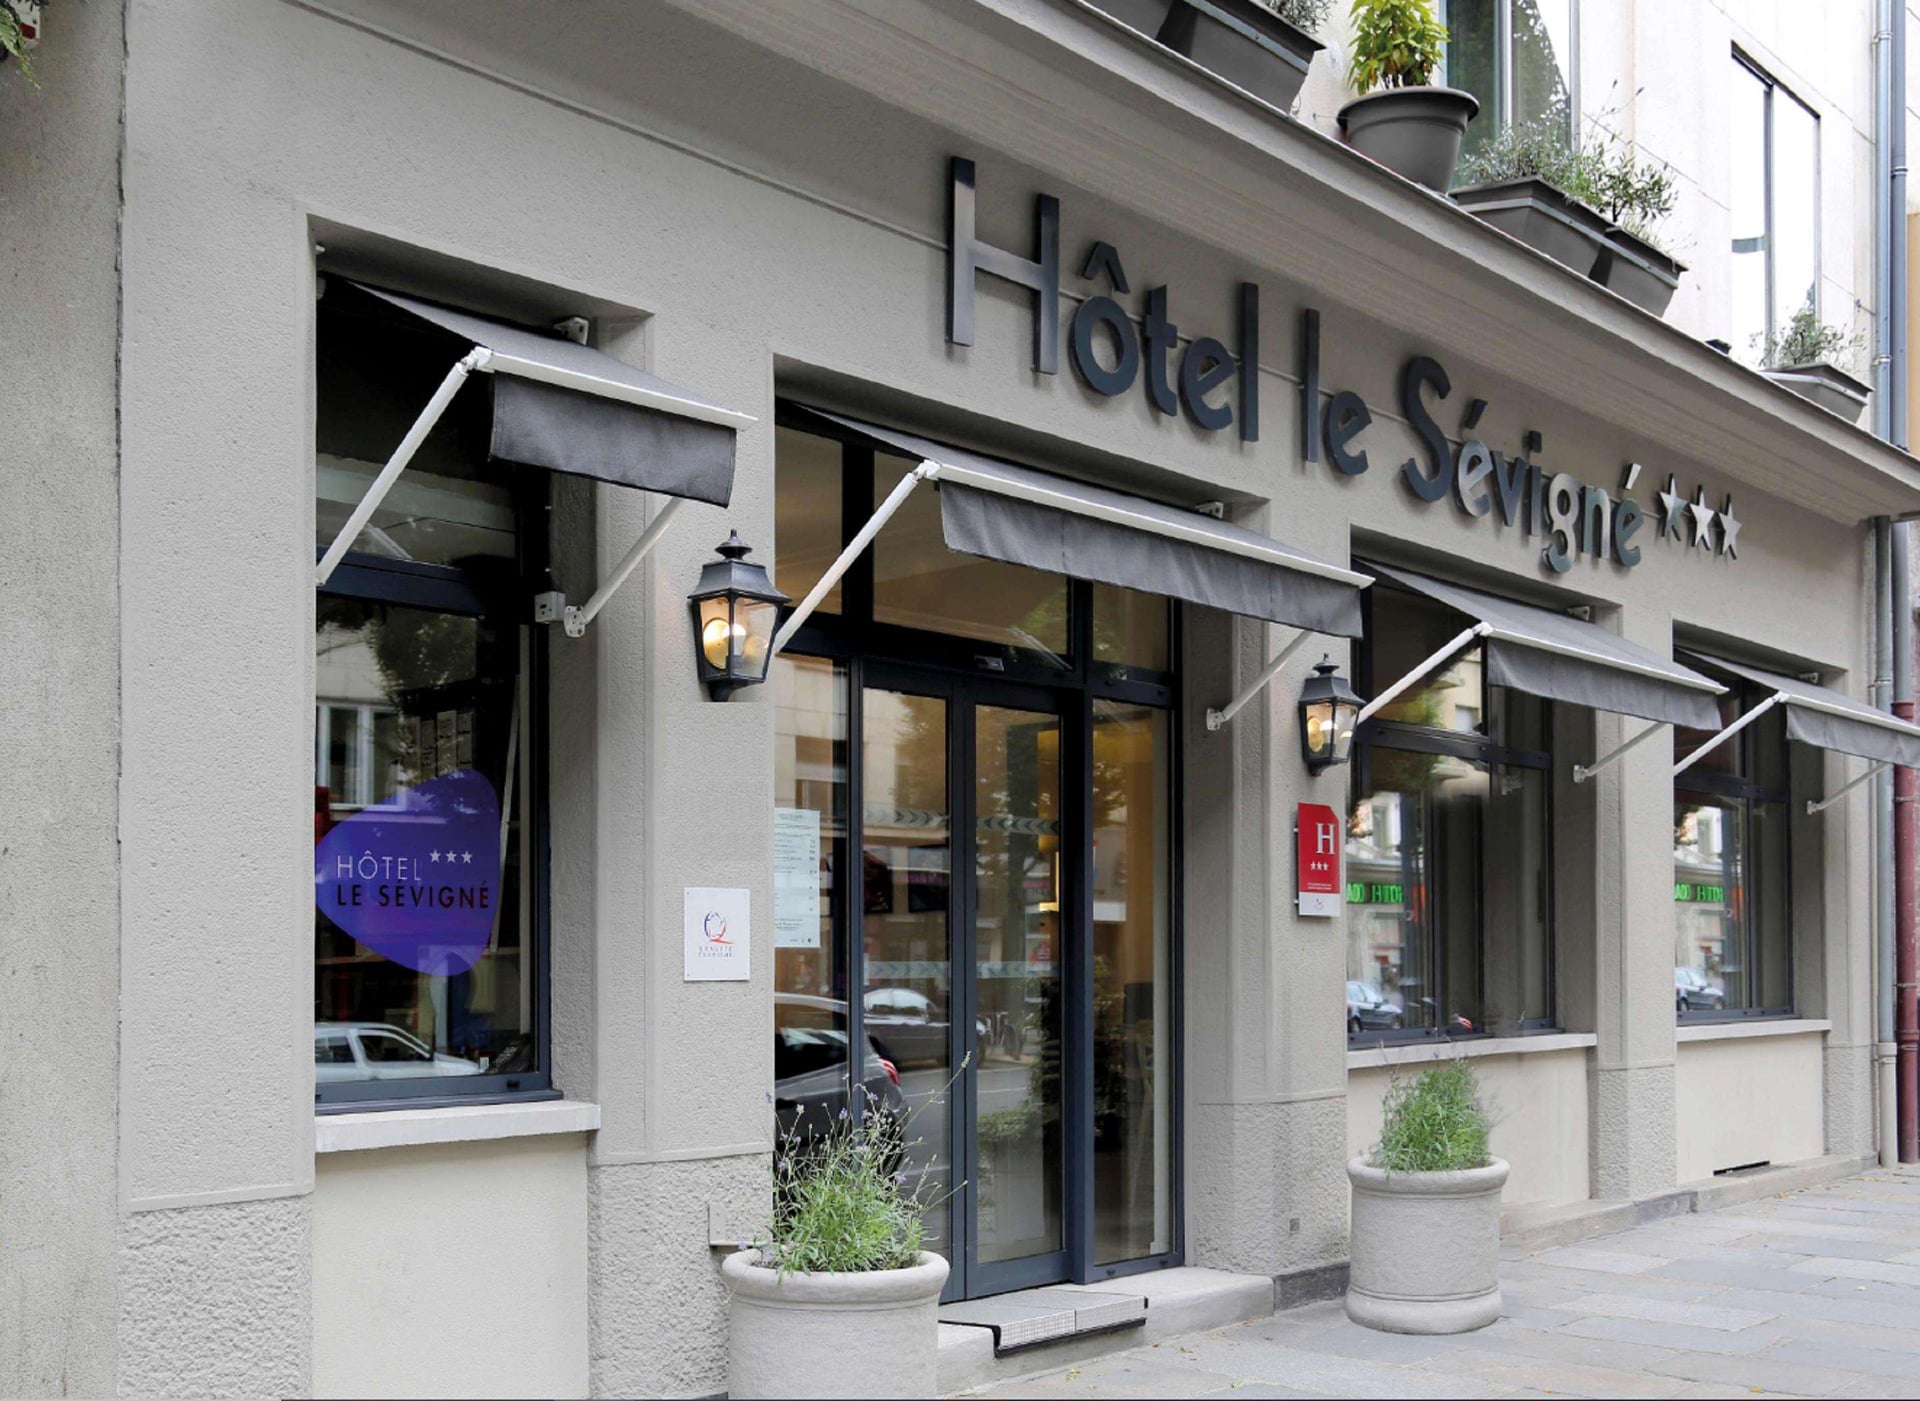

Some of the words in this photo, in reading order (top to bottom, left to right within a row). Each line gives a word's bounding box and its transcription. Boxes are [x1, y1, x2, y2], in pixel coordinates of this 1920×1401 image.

[946, 156, 1259, 442] Hôtel
[1299, 308, 1371, 475] le
[1401, 355, 1643, 574] Sévigné
[1316, 822, 1335, 855] H
[337, 850, 421, 881] HÔTEL
[337, 884, 362, 906] LE
[379, 879, 489, 909] SÉVIGNÉ
